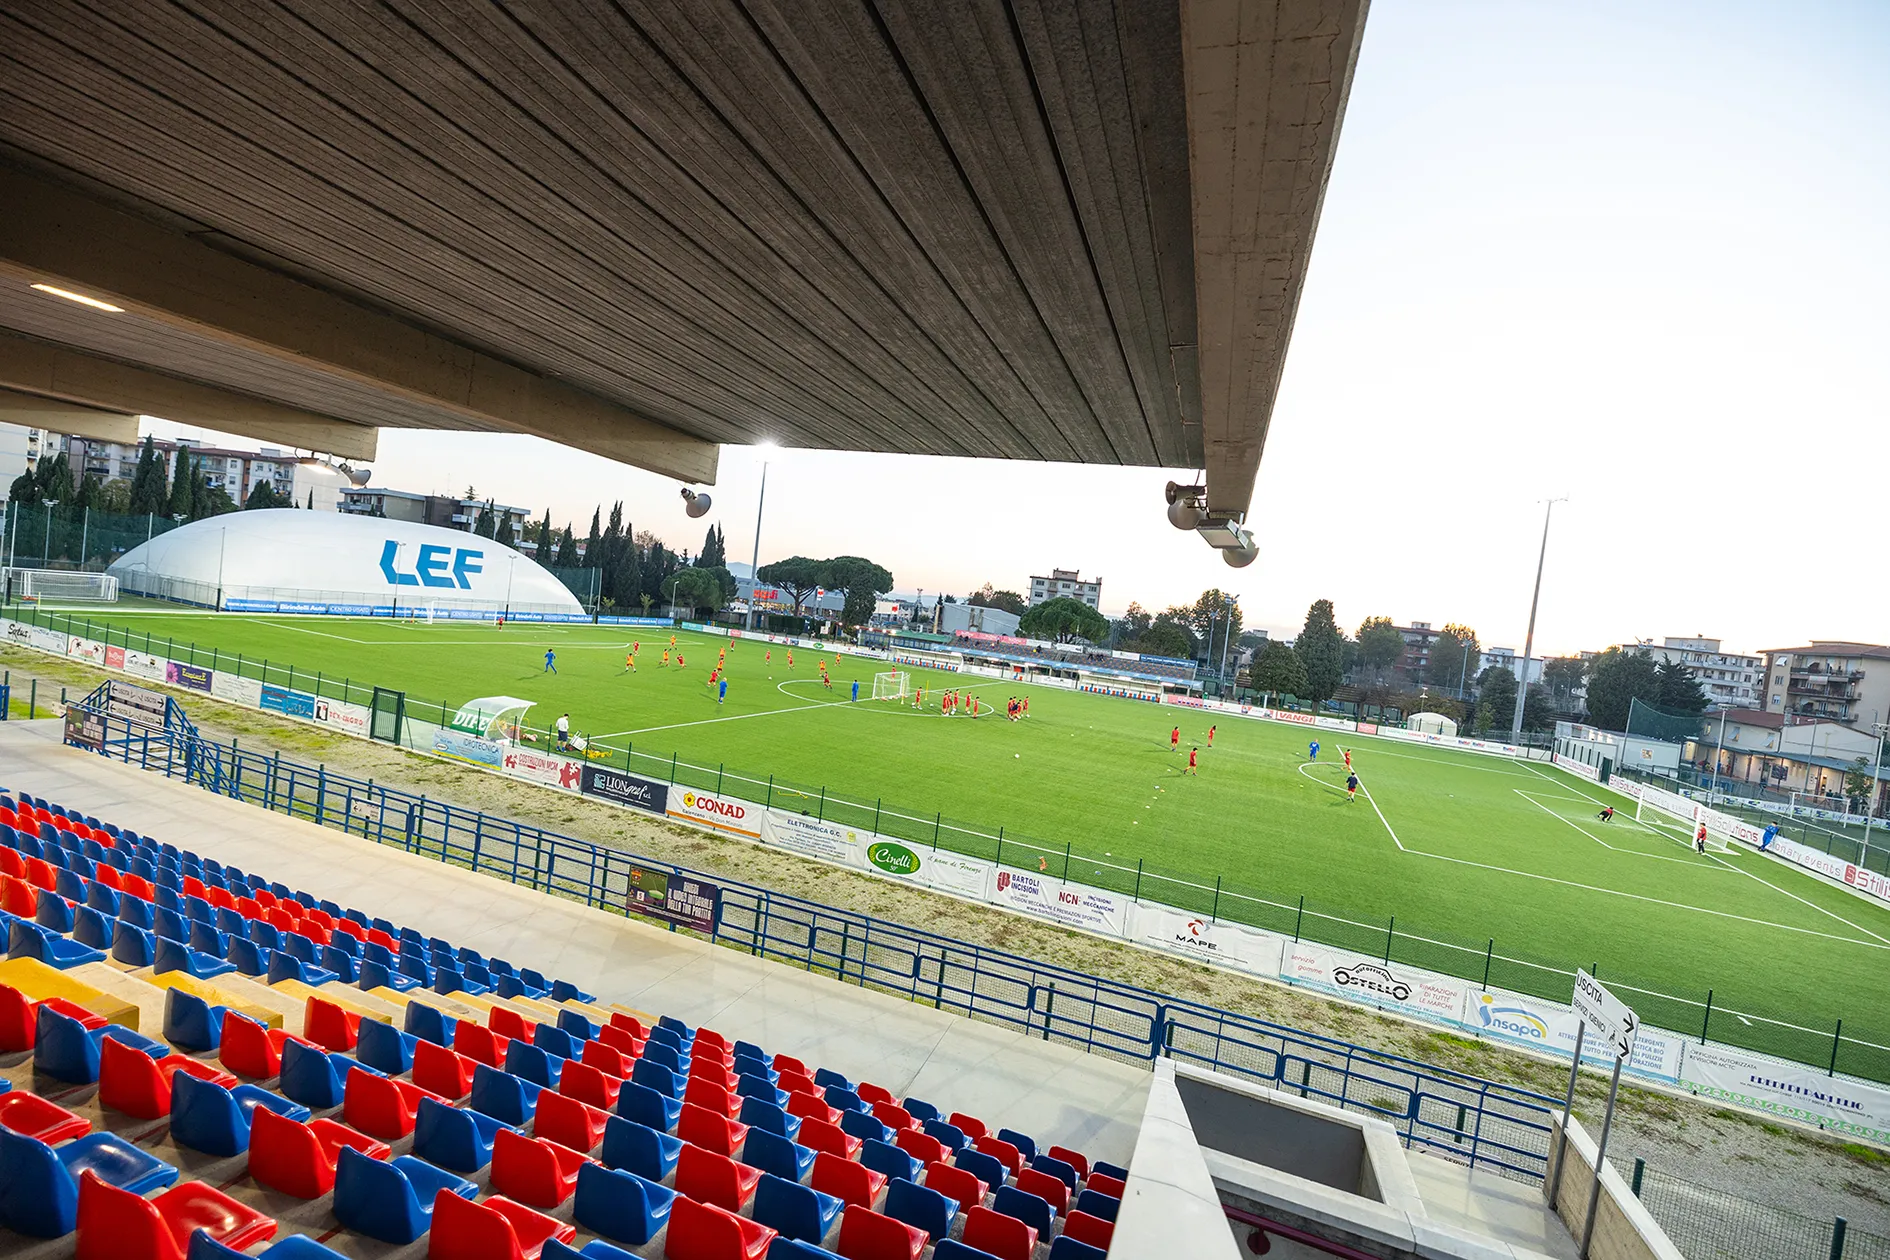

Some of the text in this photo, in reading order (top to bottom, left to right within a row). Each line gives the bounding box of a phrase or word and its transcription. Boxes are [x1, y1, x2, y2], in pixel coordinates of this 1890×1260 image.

[379, 540, 484, 589] LEF
[452, 711, 492, 731] DIFE
[1279, 711, 1313, 724] VANGI
[696, 796, 745, 819] CONAD
[787, 818, 829, 834] ELETTRONICA
[876, 848, 911, 868] Cinelli
[1804, 855, 1841, 877] events
[1011, 873, 1040, 888] BARTOLI
[1011, 882, 1039, 896] INCISIONI
[1058, 891, 1079, 906] NCN
[1082, 900, 1115, 914] MECCANICHE
[1175, 934, 1217, 951] MAPE
[1291, 954, 1315, 965] servizio
[1297, 964, 1323, 975] gomme
[1334, 970, 1409, 1001] OSTELLO
[1419, 983, 1458, 997] RIPARAZIONI
[1576, 974, 1603, 1006] USCITA
[1427, 999, 1454, 1011] MARCHE
[1573, 996, 1589, 1017] SERVIZI
[1584, 1046, 1602, 1055] TUTTO
[1653, 1047, 1665, 1055] BIO
[1690, 1049, 1757, 1070] OFFICINA AUTORIZZATA
